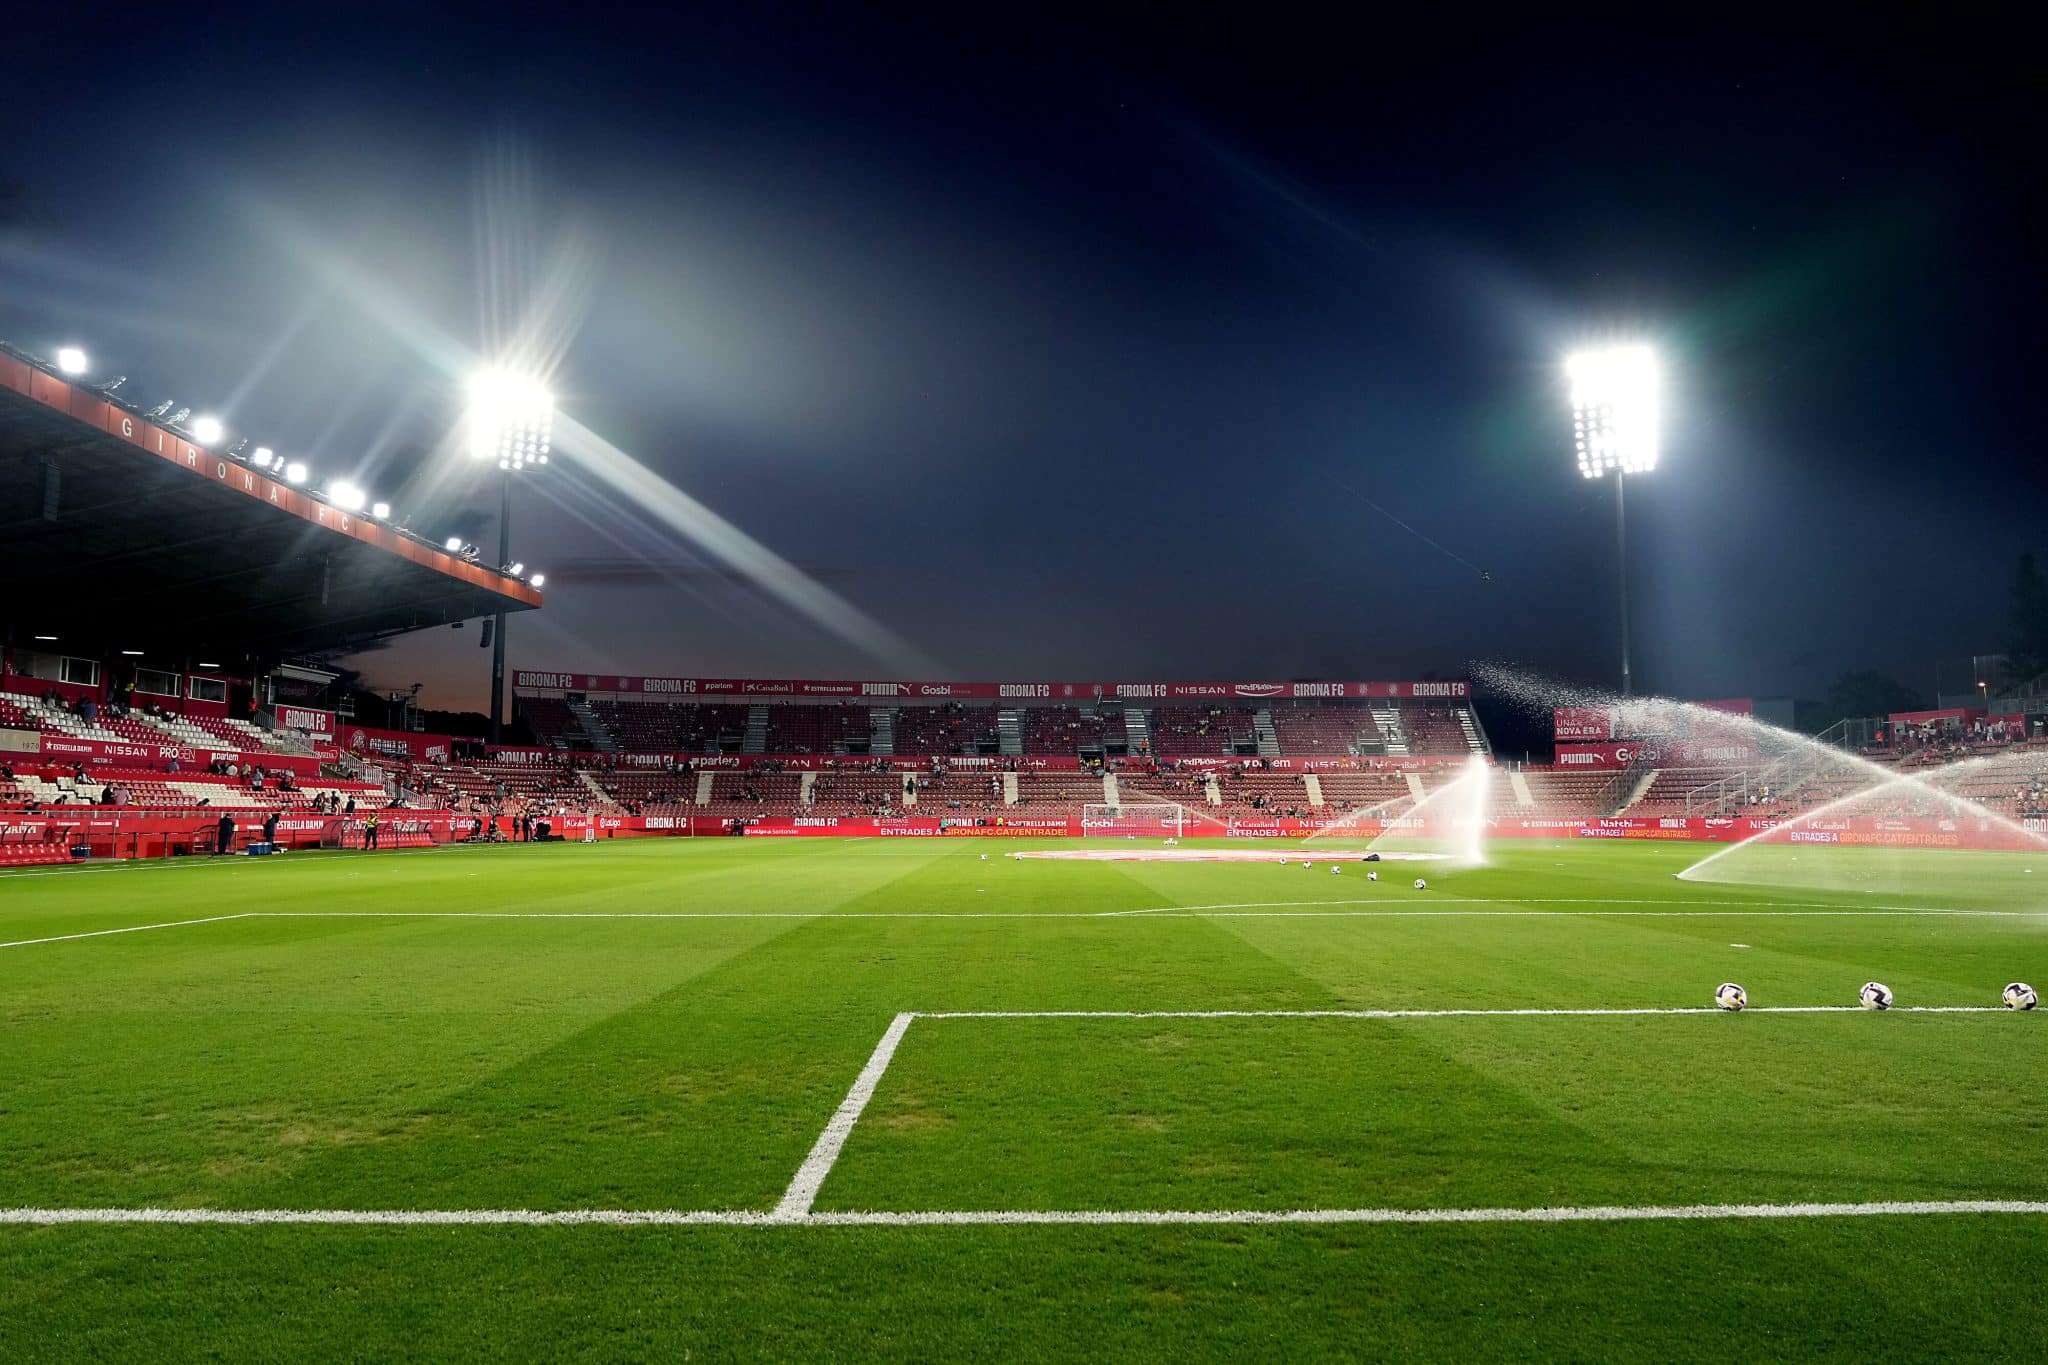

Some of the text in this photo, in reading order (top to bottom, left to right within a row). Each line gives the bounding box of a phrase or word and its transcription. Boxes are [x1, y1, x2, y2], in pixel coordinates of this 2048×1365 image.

[122, 418, 348, 531] GIRONA FC
[519, 672, 572, 688] GIRONA FC
[644, 679, 696, 693] GIRONA FC
[921, 685, 951, 695] Gosbi
[1000, 684, 1049, 697] GIRONA FC
[1117, 684, 1166, 697] GIRONA FC
[1294, 683, 1344, 696] GIRONA FC
[1413, 682, 1464, 696] GIRONA FC
[286, 709, 326, 731] GIRONA FC
[1557, 727, 1581, 735] NOVA
[104, 745, 148, 757] NISSAN
[160, 747, 196, 760] PROGEN
[645, 817, 687, 828] GIRONA FC
[793, 817, 838, 827] GIRONA FC
[1081, 818, 1114, 827] Gosbi
[1299, 820, 1357, 828] NISSAN
[880, 828, 933, 836] ENTRADES
[935, 828, 942, 836] A
[1227, 829, 1278, 837] ENTRADES
[1280, 829, 1287, 837] A
